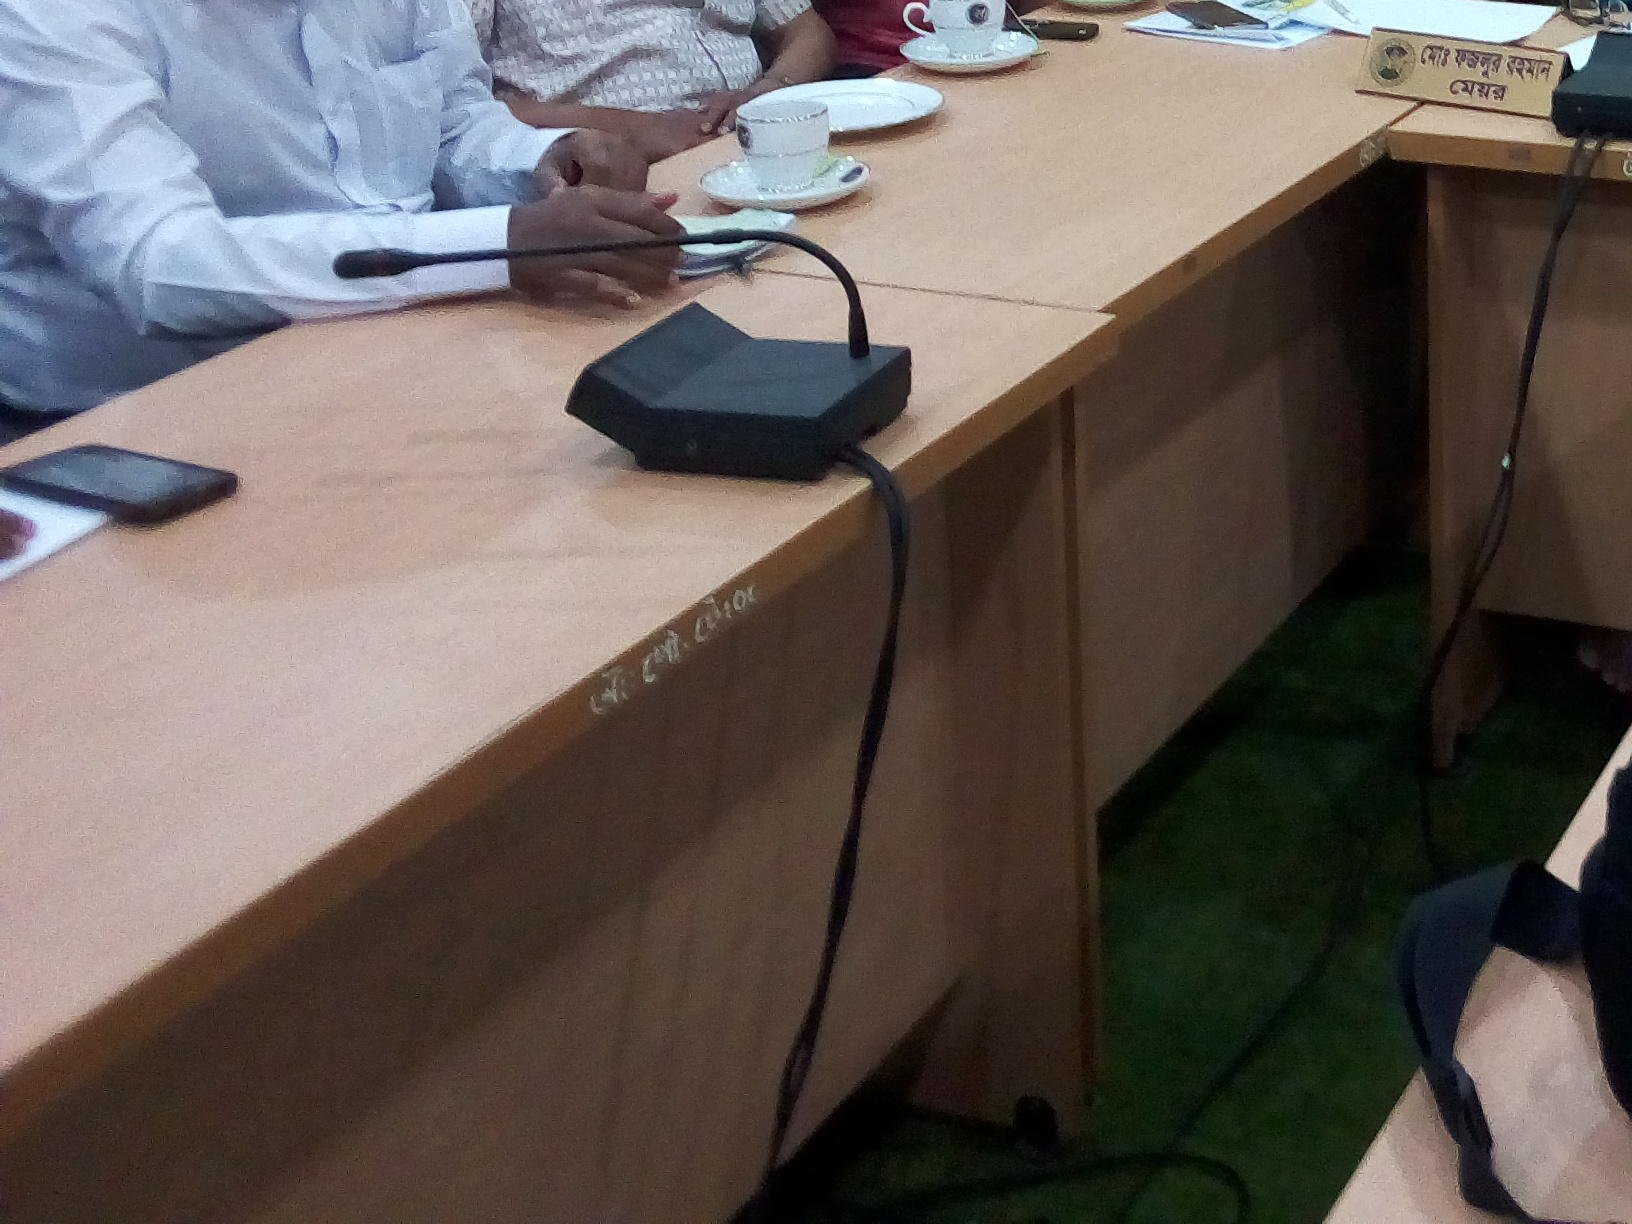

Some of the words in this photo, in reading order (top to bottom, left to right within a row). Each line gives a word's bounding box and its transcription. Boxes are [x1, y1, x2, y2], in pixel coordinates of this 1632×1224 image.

[1420, 44, 1450, 68] মোঃ
[1454, 48, 1503, 80] ফজলুর
[1506, 54, 1555, 81] রহমান
[1449, 79, 1508, 102] মেয়র
